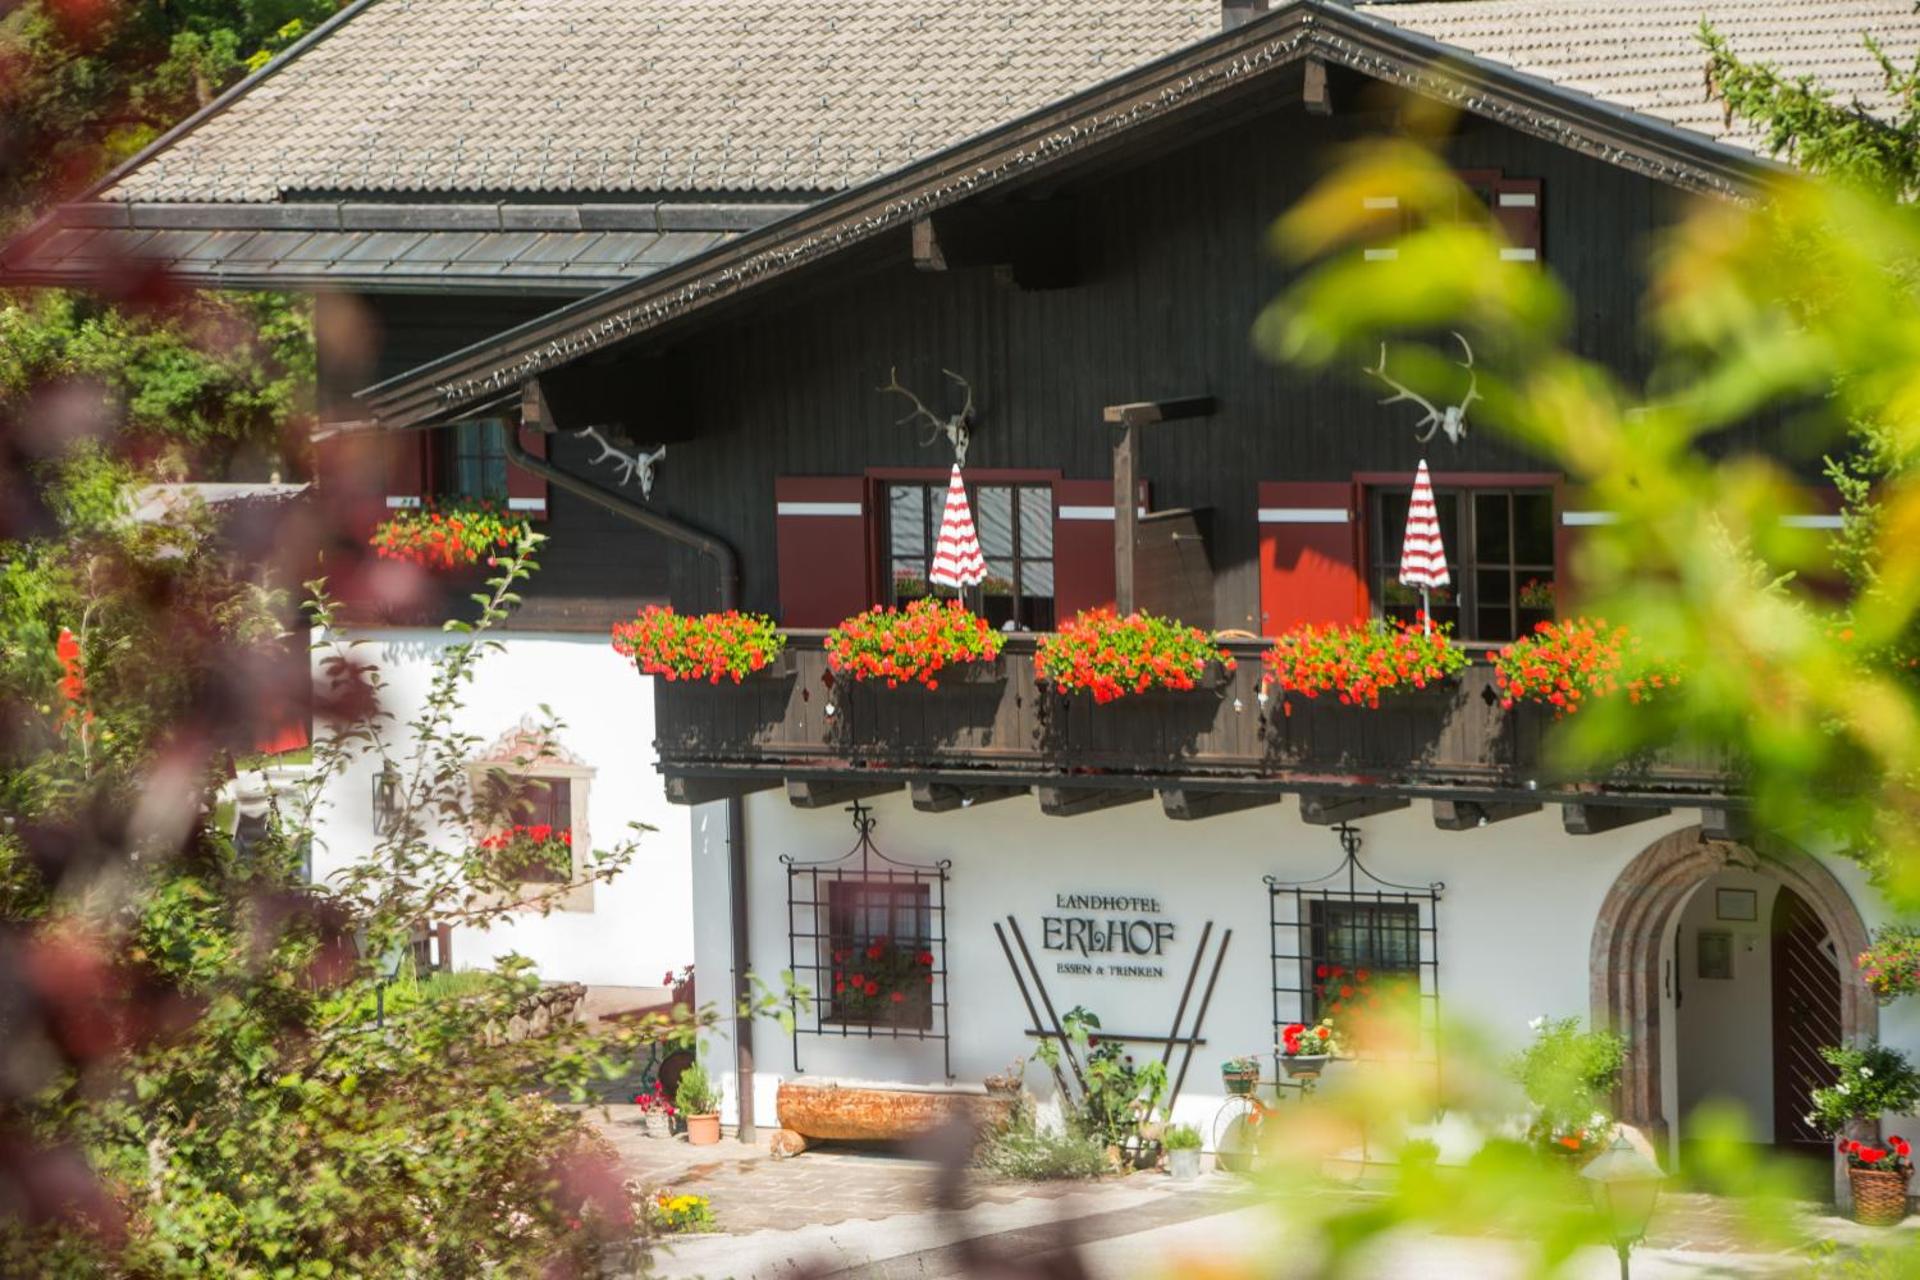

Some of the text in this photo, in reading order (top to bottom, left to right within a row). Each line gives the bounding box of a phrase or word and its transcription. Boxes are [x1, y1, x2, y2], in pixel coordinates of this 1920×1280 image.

[1056, 893, 1161, 912] LANDHOTEL
[1042, 916, 1175, 958] ERLHOF
[1056, 963, 1163, 977] ESSEN & TRINKEN
